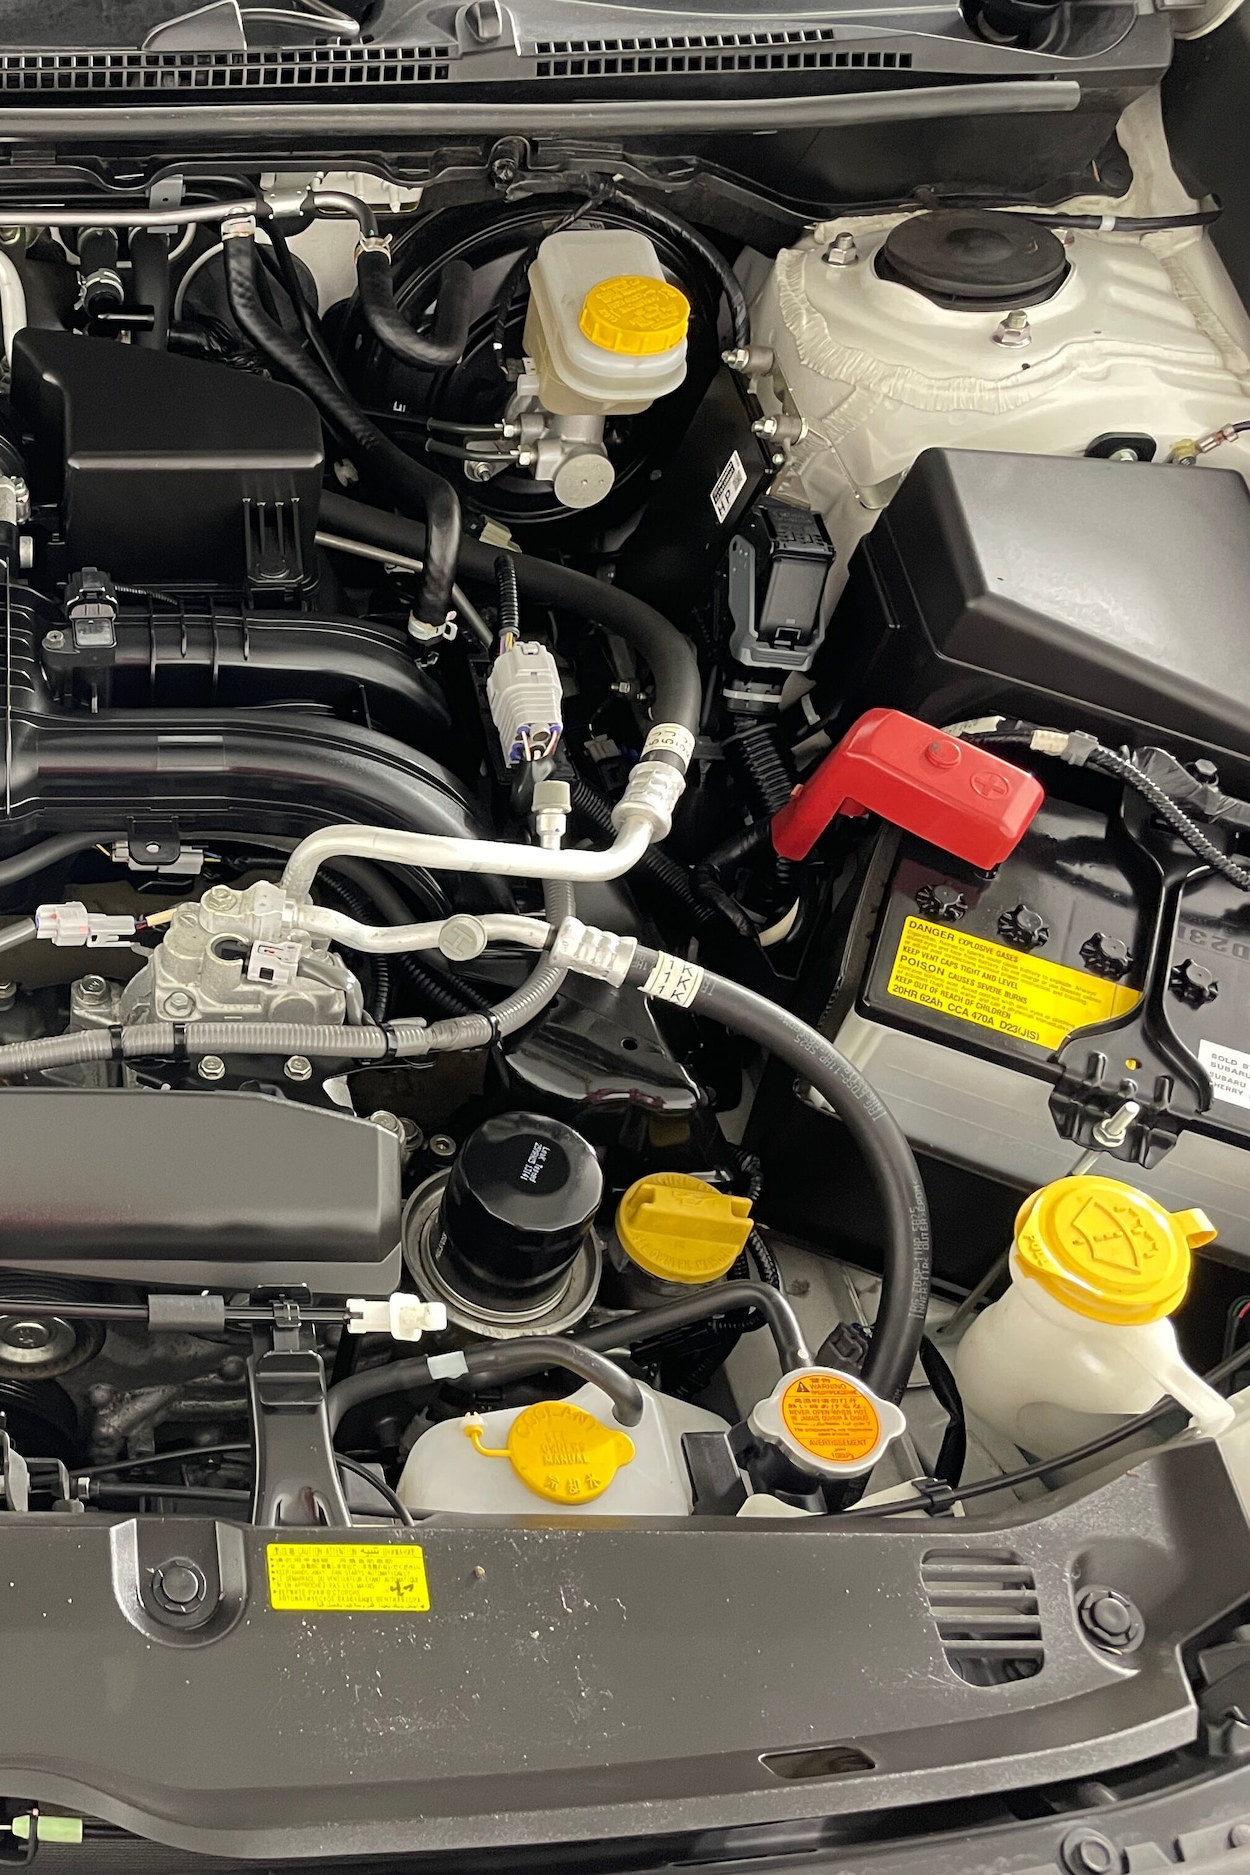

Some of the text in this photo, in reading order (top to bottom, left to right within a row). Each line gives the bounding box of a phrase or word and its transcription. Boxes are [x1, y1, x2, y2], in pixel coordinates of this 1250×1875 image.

[908, 920, 1020, 963] DANGER EXPLOSIVE GASES
[898, 954, 1029, 1005] POISON CAUSES SEVERE BURNS
[902, 945, 1020, 990] KEEP VENT CAPS TIGHT AND LEVEL
[892, 984, 1040, 1041] 20HR 62Ah CCA 470A D23(JIS)
[894, 974, 1012, 1020] KEEP OUT OF REACH OF CHILDREN
[1208, 1071, 1247, 1088] SUBARU
[1210, 1053, 1239, 1066] SOLD
[542, 1453, 589, 1467] MANUAL
[298, 1547, 323, 1556] CAUTION
[325, 1547, 358, 1556] ATTENTION
